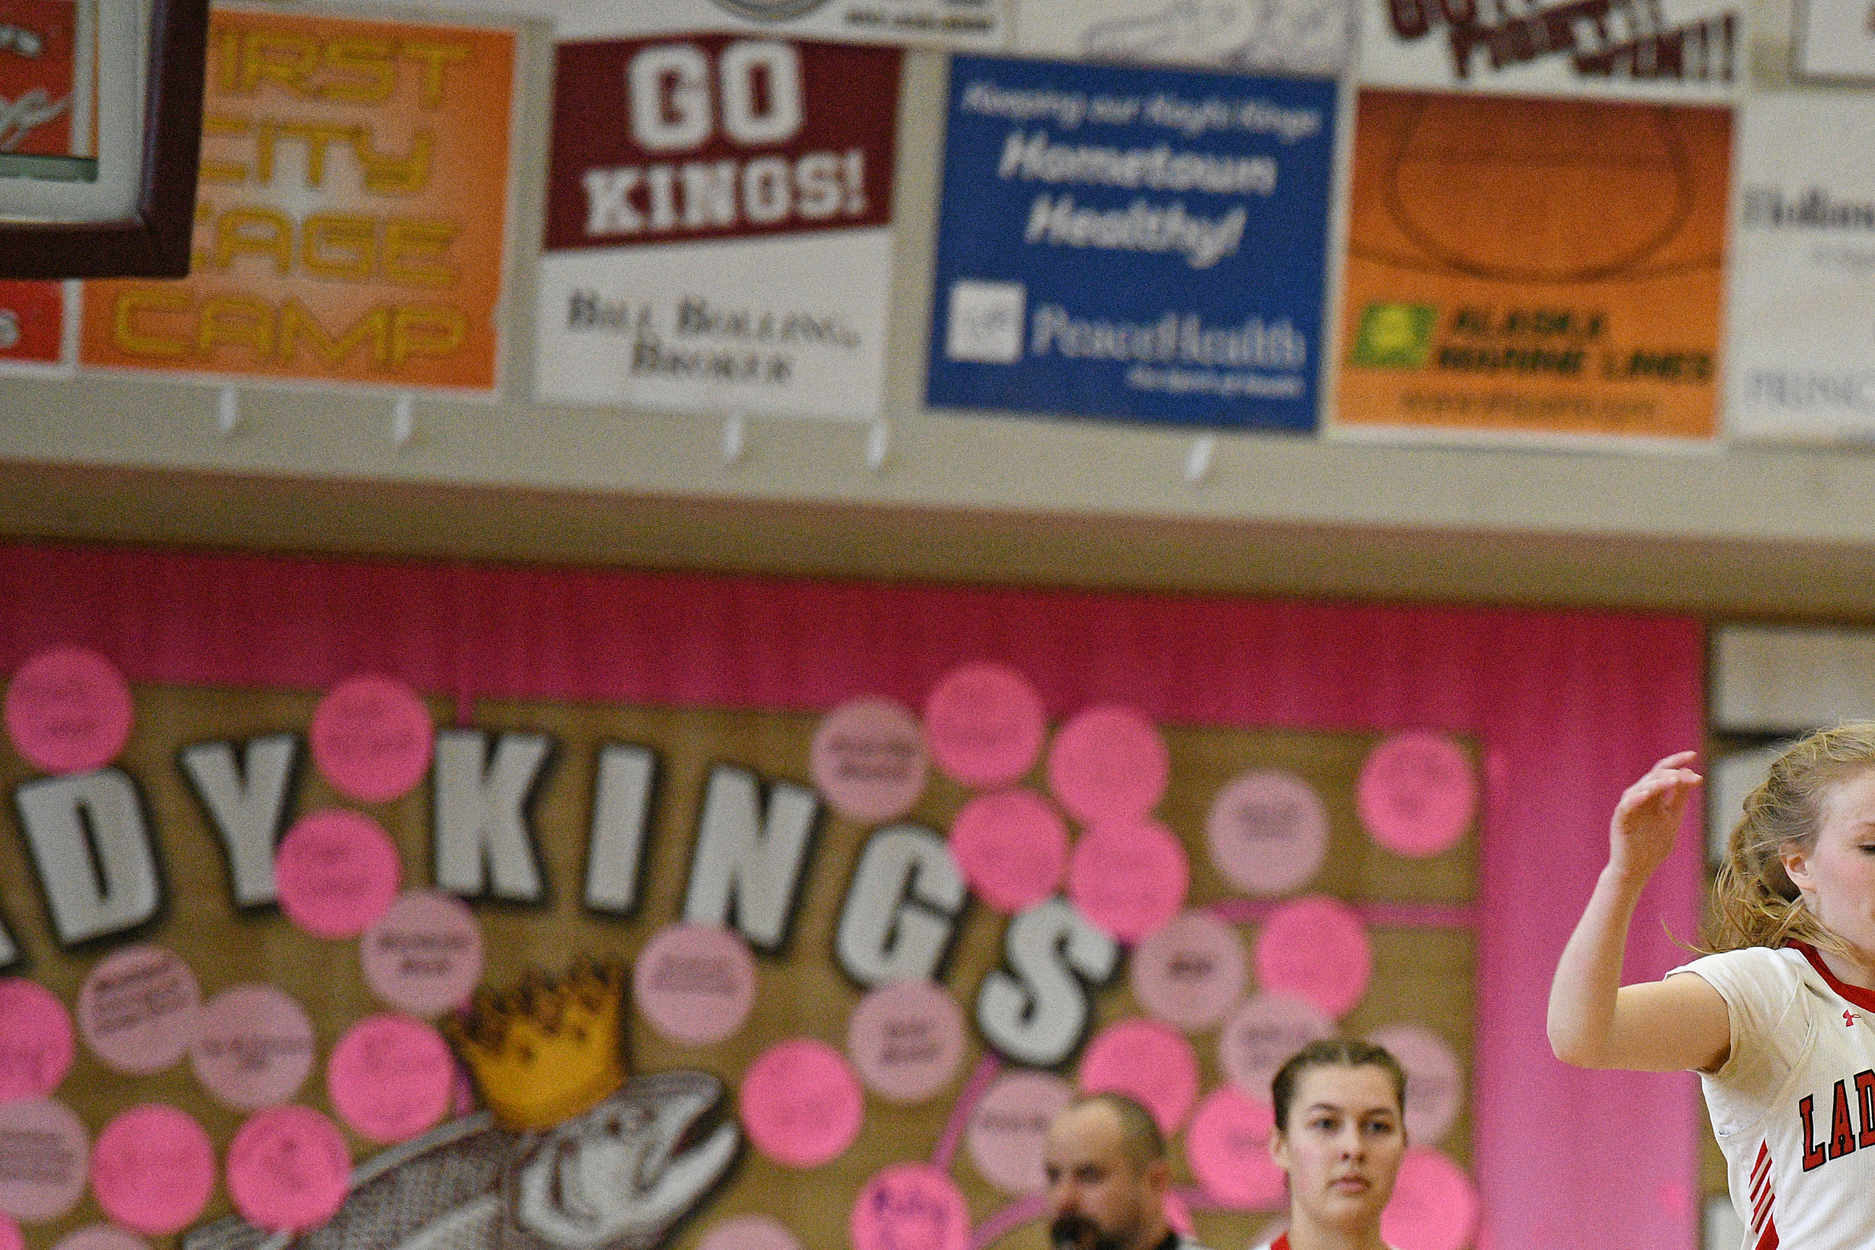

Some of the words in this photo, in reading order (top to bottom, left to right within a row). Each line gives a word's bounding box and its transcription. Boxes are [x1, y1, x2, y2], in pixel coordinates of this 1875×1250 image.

[211, 31, 471, 106] IRST
[628, 40, 803, 151] GO
[584, 149, 866, 235] KINGS!
[998, 130, 1278, 195] Hometown
[194, 205, 457, 282] AGE
[1025, 193, 1247, 269] Healthy!
[114, 290, 467, 368] CAMP
[1032, 304, 1305, 368] PeaceHealth
[432, 728, 1120, 1070] KINGS
